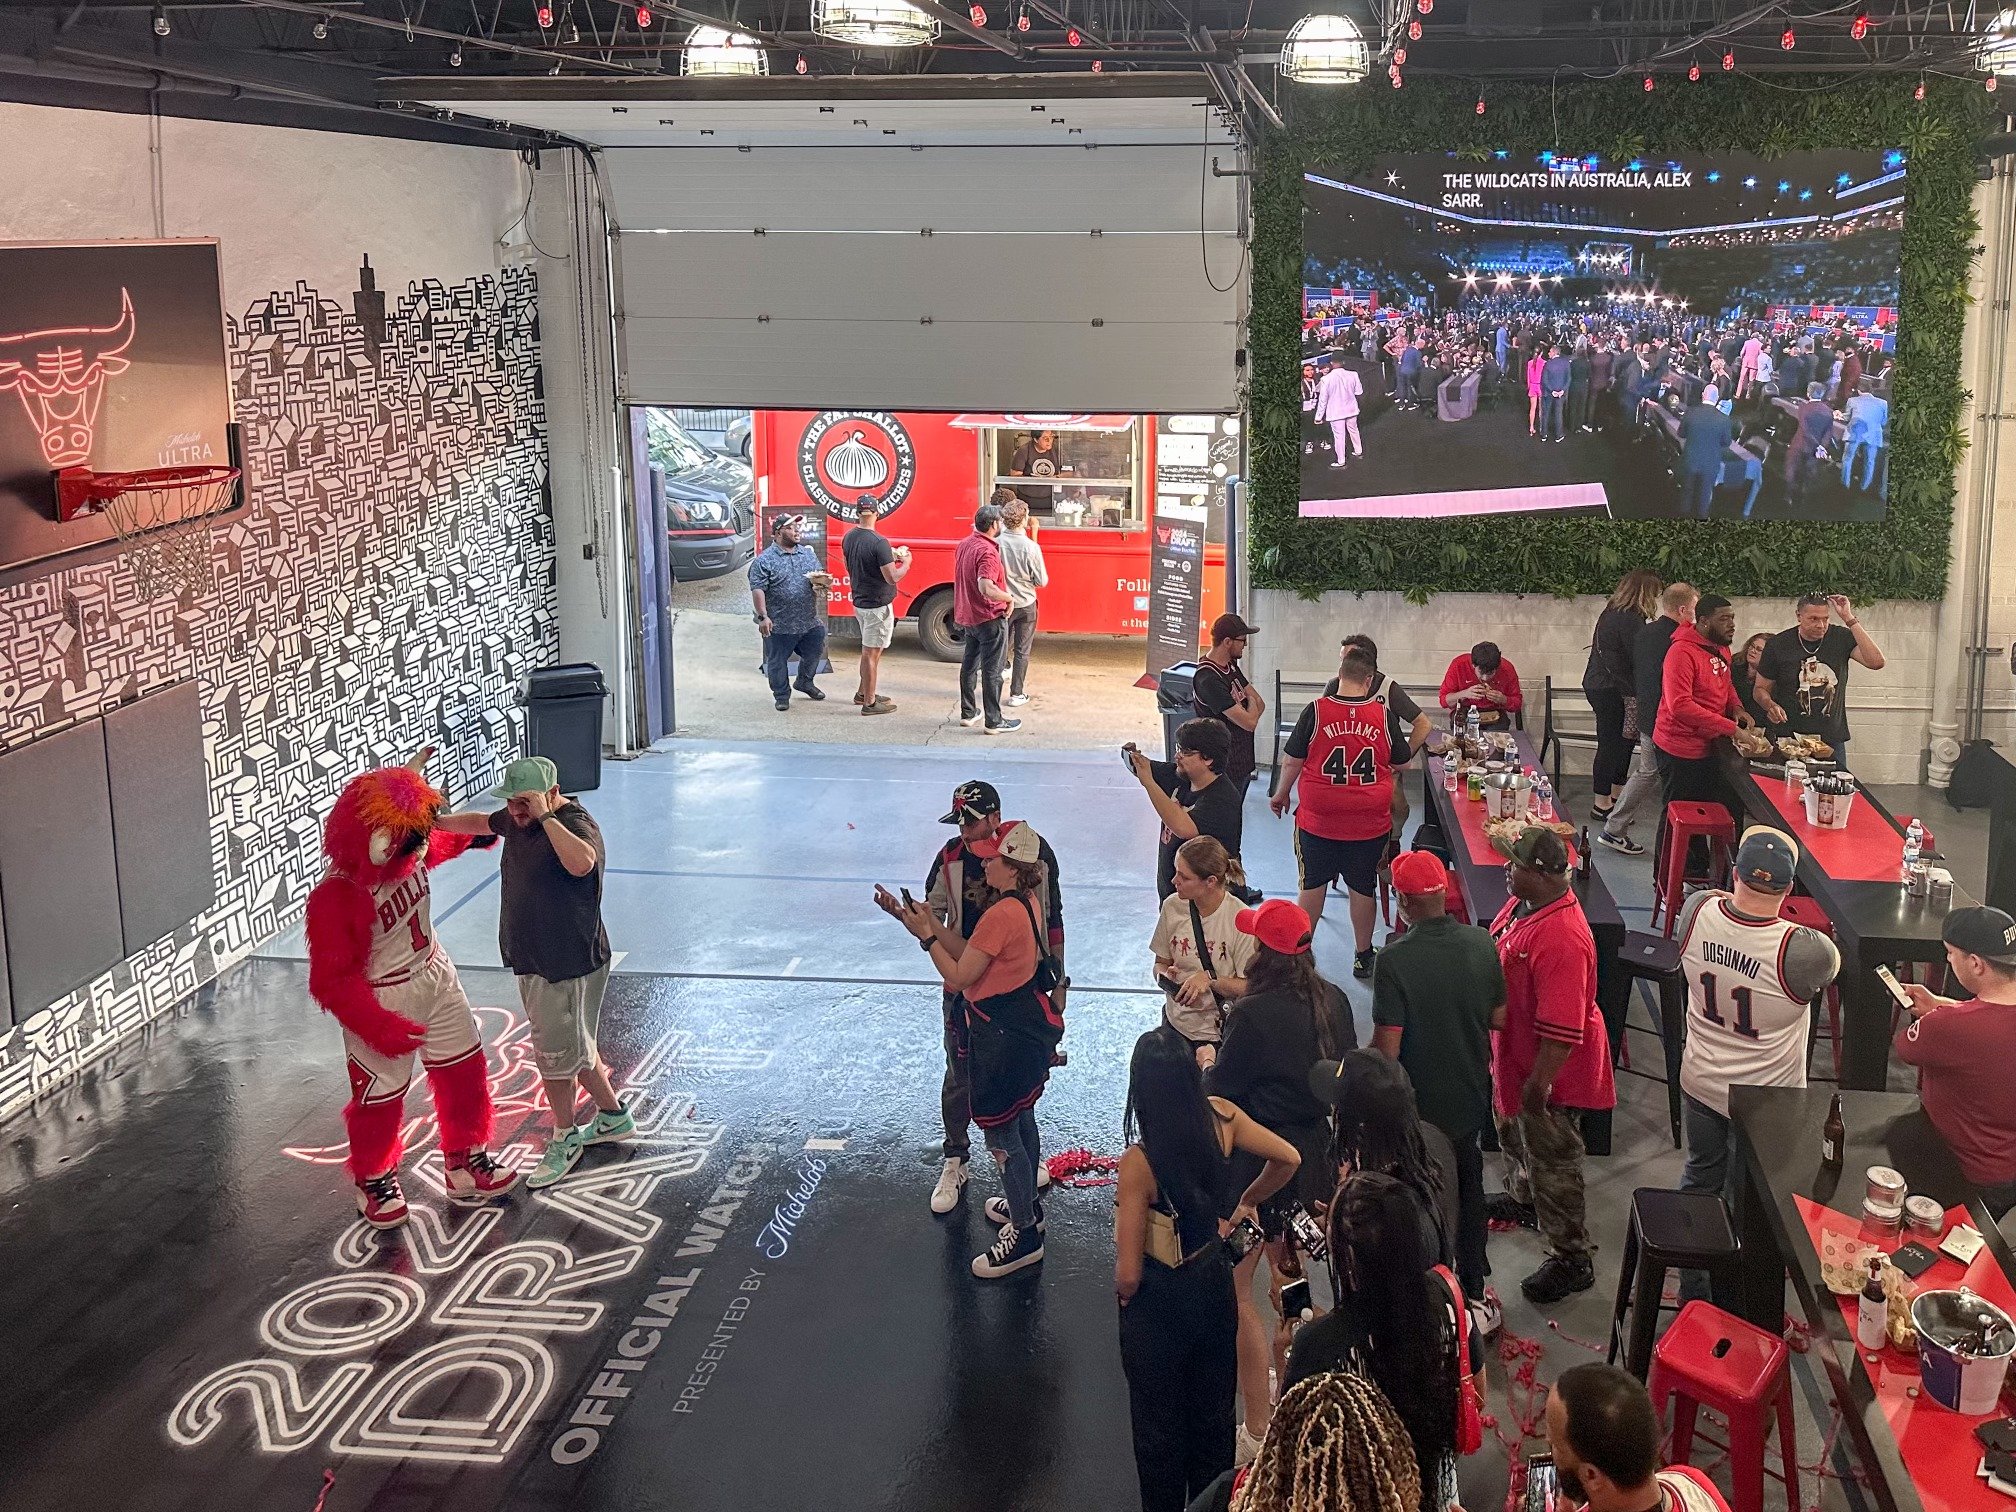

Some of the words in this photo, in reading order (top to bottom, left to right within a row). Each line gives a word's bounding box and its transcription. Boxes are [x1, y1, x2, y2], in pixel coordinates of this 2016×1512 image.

[1442, 173, 1472, 188] THE
[1474, 173, 1548, 188] WILDCATS
[1550, 173, 1567, 188] IN
[1569, 173, 1652, 190] AUSTRALIA,
[1654, 172, 1692, 188] ALEX
[1442, 193, 1484, 208] SARR.
[158, 442, 213, 468] ULTRA
[803, 420, 827, 450] THE
[802, 464, 841, 514] CLASSIC
[841, 468, 912, 520] SAWICHES
[481, 741, 499, 757] OTTO
[1322, 720, 1381, 742] WILLIAMS
[1321, 746, 1377, 786] 44
[407, 909, 430, 953] 1
[1702, 940, 1761, 980] DOSUNMU
[1699, 970, 1760, 1041] 11
[330, 1029, 775, 1464] DRAFT
[672, 1296, 751, 1414] PRESENTED
[739, 1267, 767, 1291] BY
[755, 1154, 828, 1259] Michelob
[550, 1267, 702, 1465] OFFICIAL
